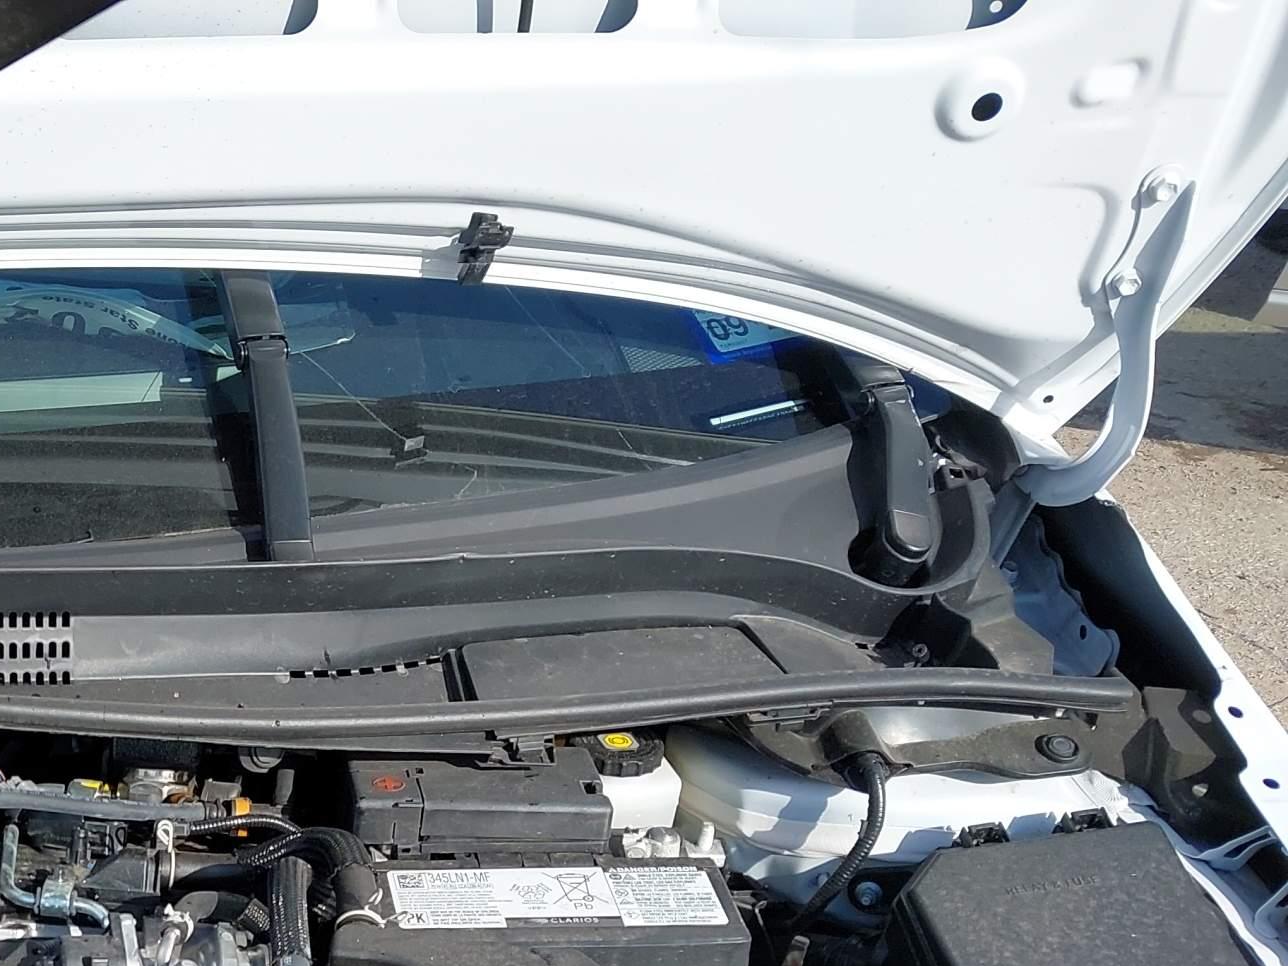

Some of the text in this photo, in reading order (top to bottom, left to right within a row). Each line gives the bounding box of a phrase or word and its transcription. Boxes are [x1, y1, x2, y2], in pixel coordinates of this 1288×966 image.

[100, 307, 139, 330] Star
[616, 865, 699, 874] DANGER/POISON
[428, 871, 491, 884] 345LN1-MF
[573, 902, 594, 911] Pb
[550, 916, 600, 925] CLARIOS
